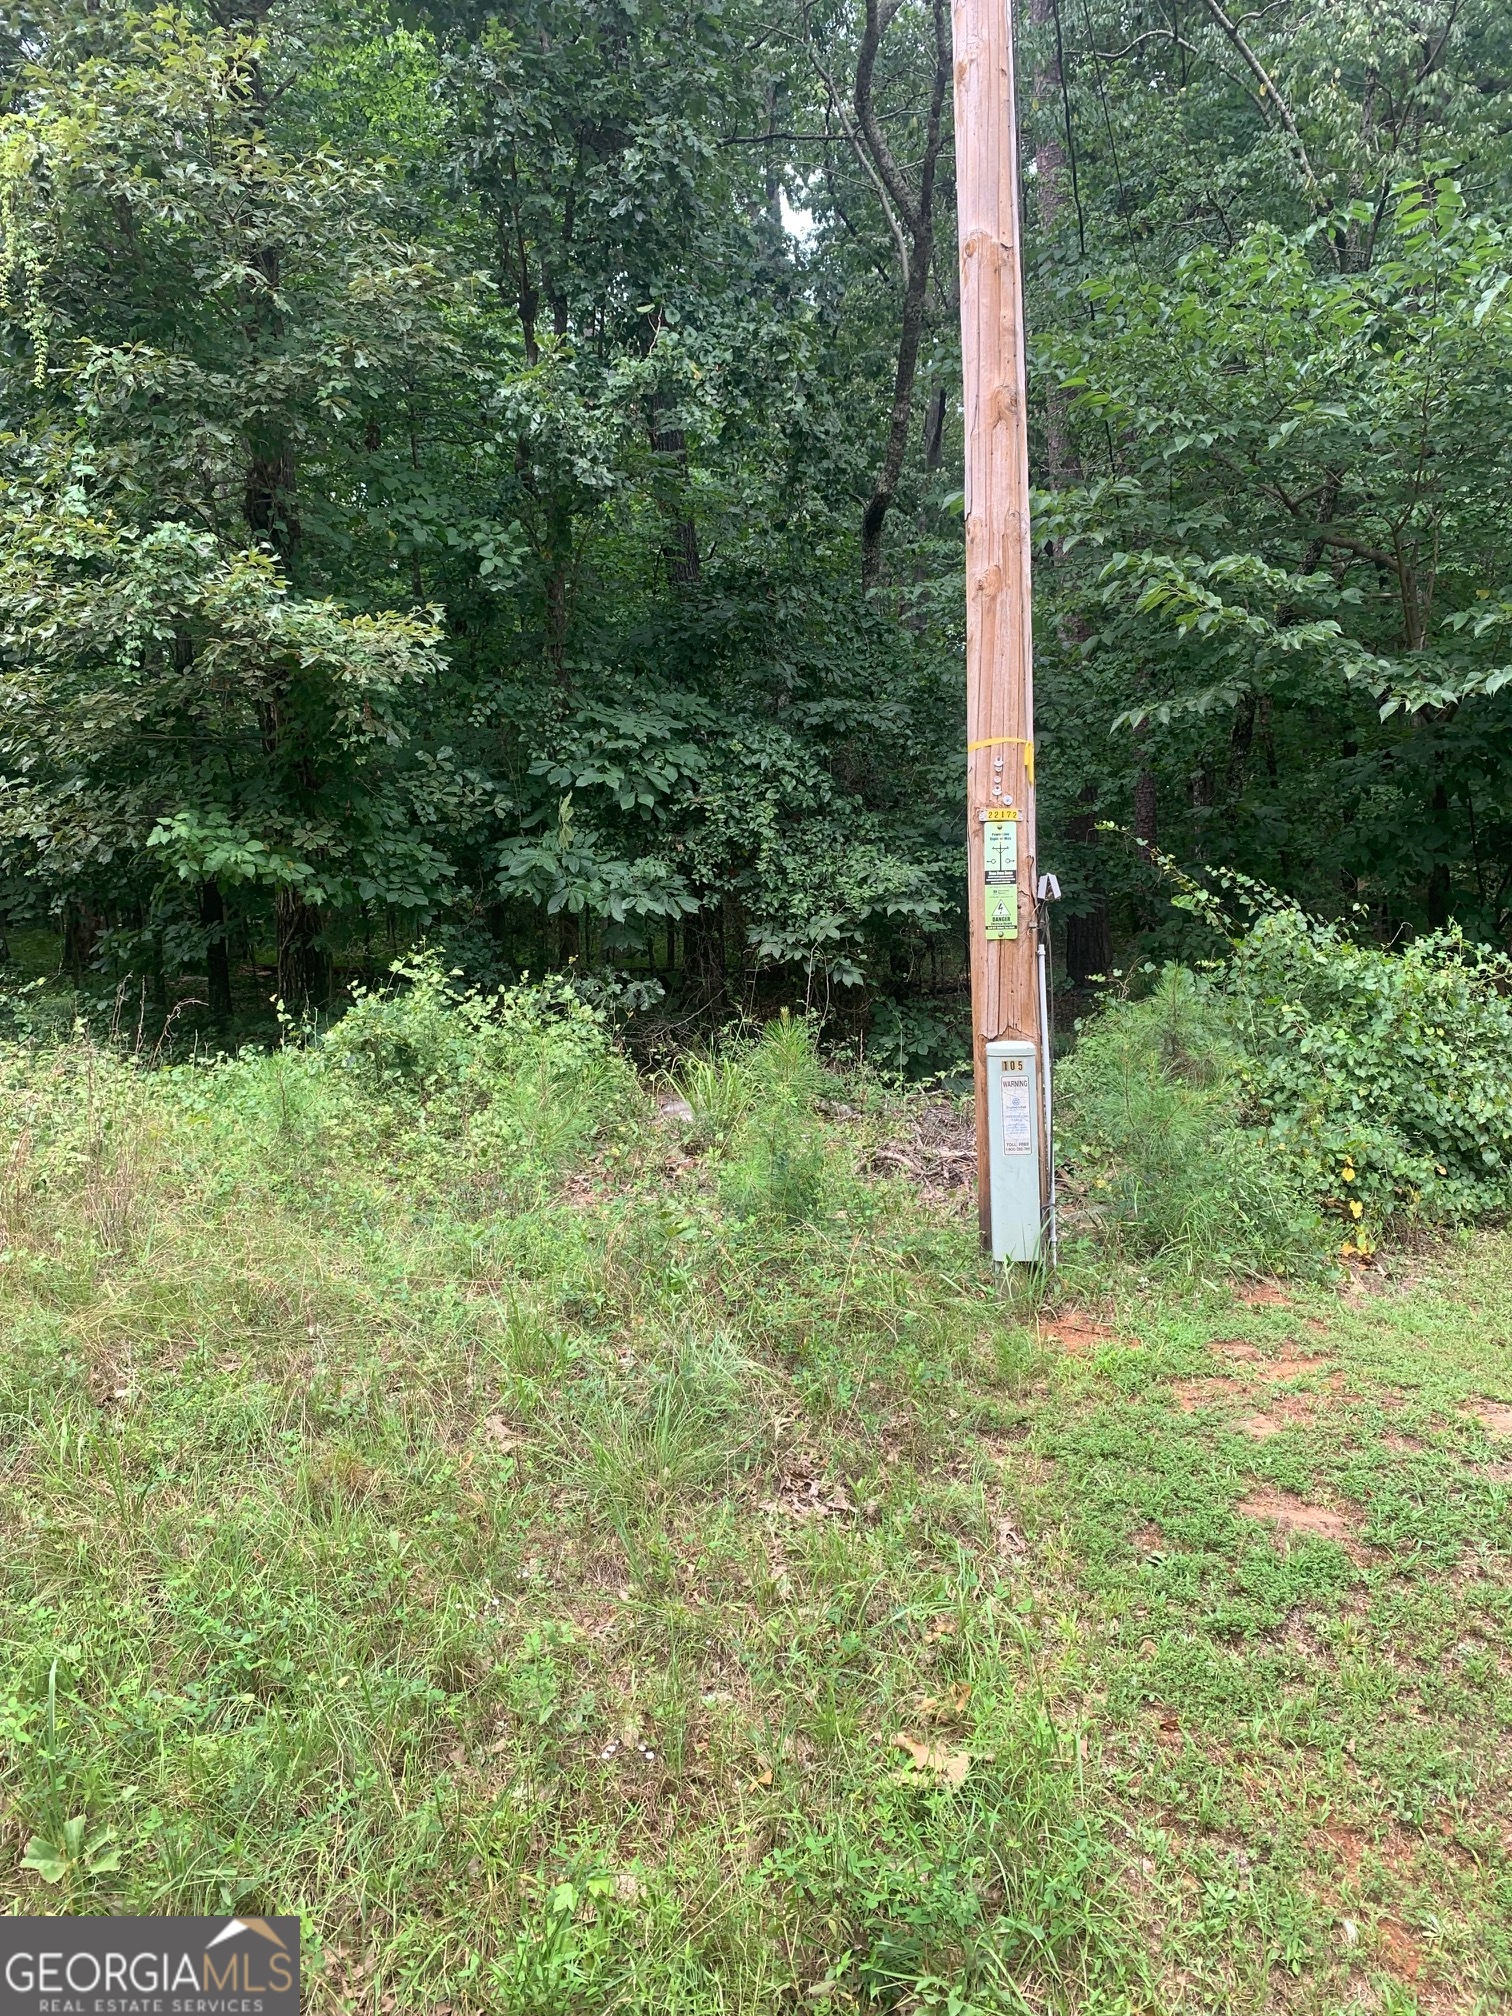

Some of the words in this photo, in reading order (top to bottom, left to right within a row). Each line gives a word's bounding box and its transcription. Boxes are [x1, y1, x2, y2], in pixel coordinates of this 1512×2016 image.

[988, 811, 1017, 819] 22172
[1004, 1060, 1023, 1071] 105
[1002, 1080, 1028, 1088] WARNING
